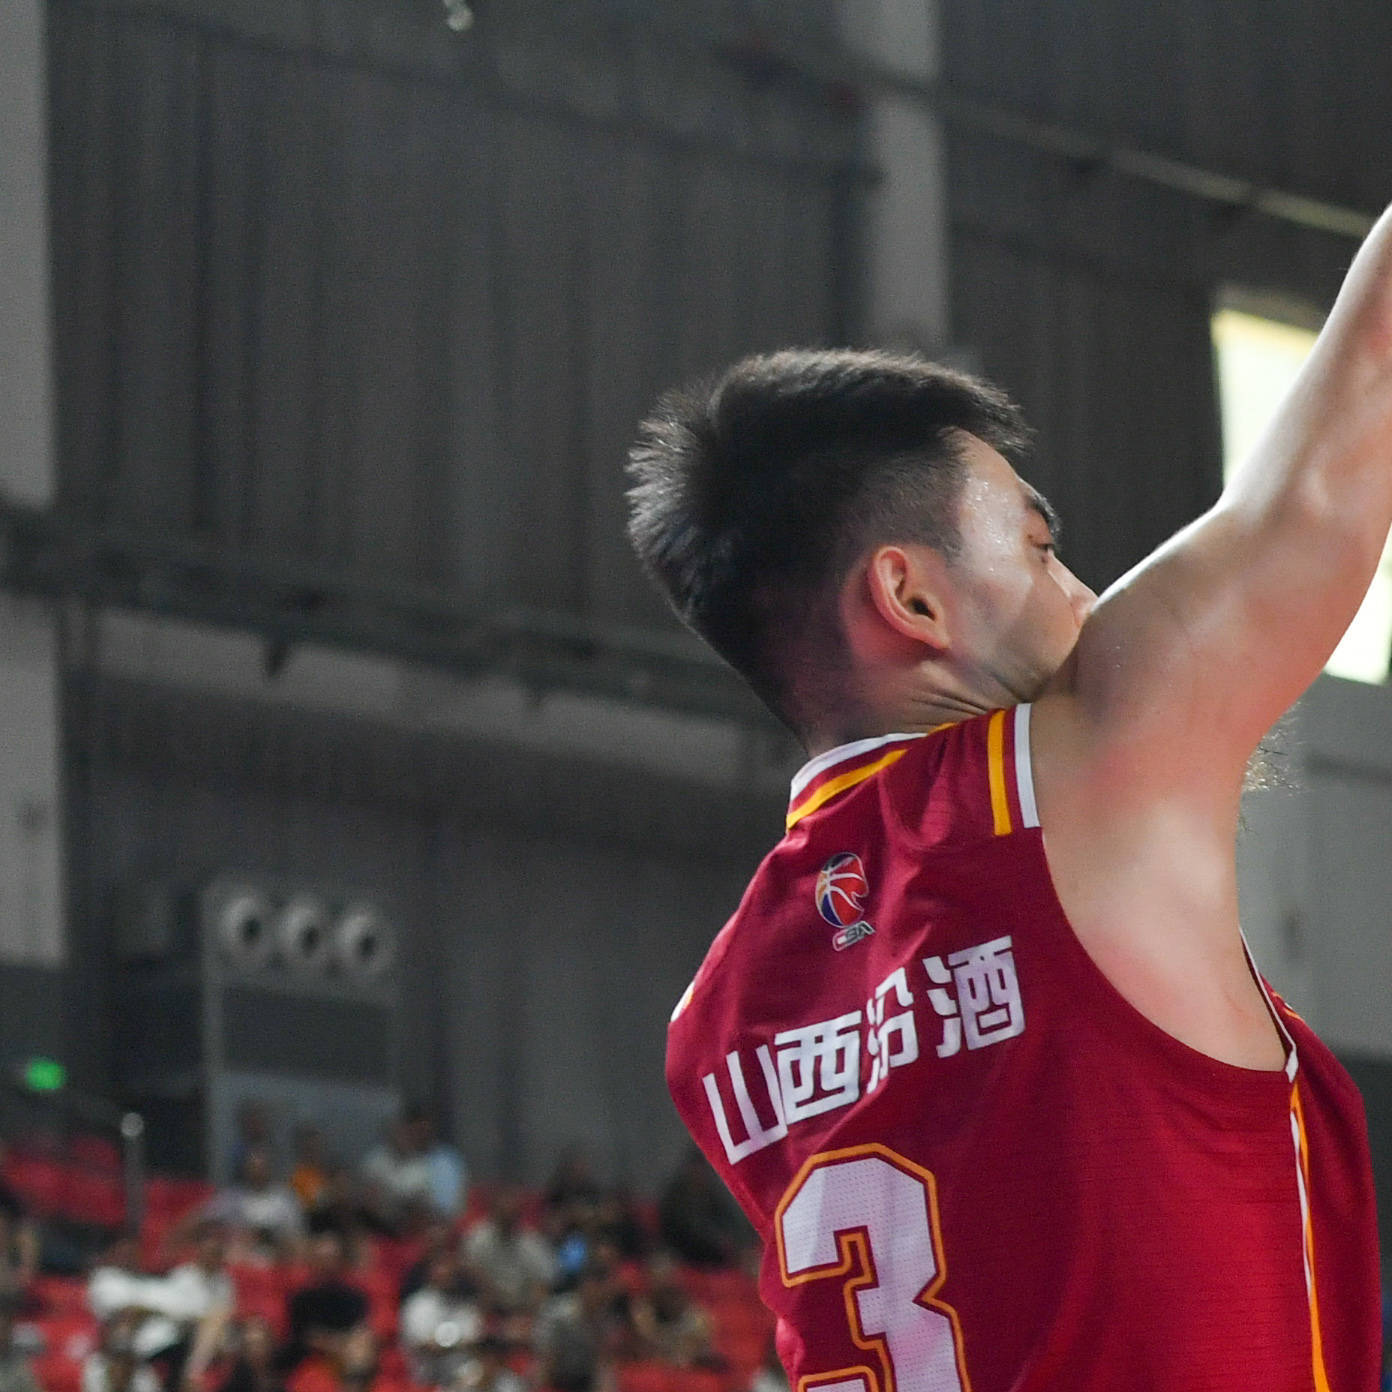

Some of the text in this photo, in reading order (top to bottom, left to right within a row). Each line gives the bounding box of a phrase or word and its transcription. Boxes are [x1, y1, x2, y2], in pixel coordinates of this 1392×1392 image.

[832, 921, 876, 951] CBA
[702, 935, 1026, 1165] 山西汾酒
